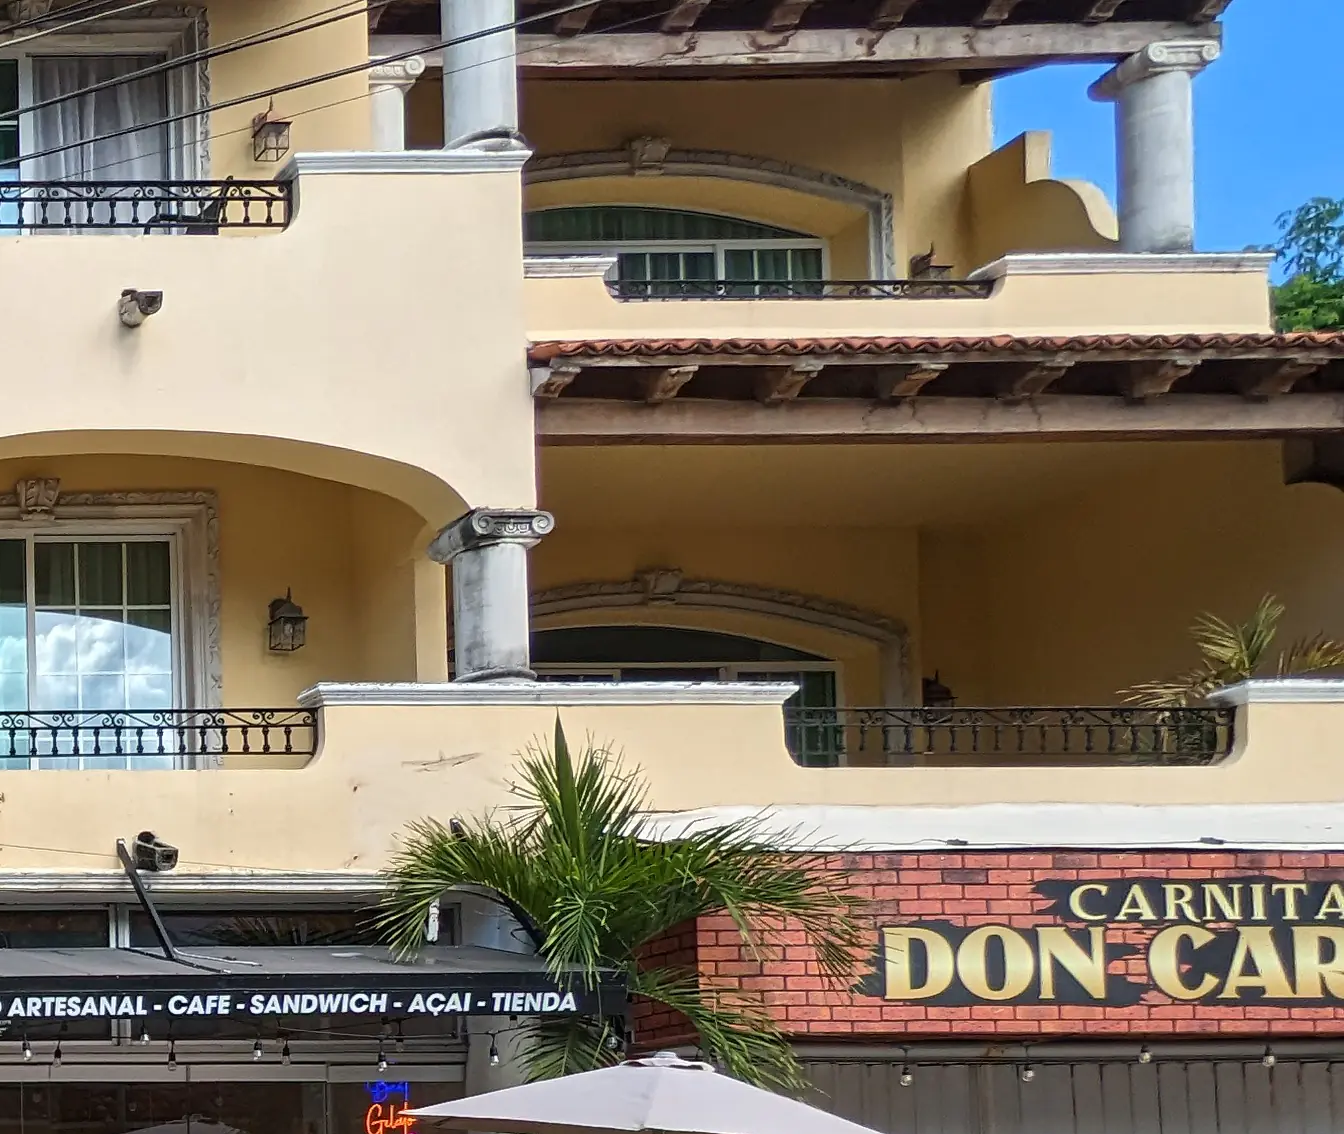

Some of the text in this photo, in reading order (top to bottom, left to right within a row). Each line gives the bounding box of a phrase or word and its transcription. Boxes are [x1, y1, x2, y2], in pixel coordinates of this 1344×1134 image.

[880, 925, 1108, 1001] DON
[7, 996, 148, 1017] ARTESANAL
[168, 994, 231, 1016] CAFE
[250, 993, 388, 1014] SANDWICH
[407, 992, 472, 1017] AÇAI
[491, 992, 577, 1012] TIENDA
